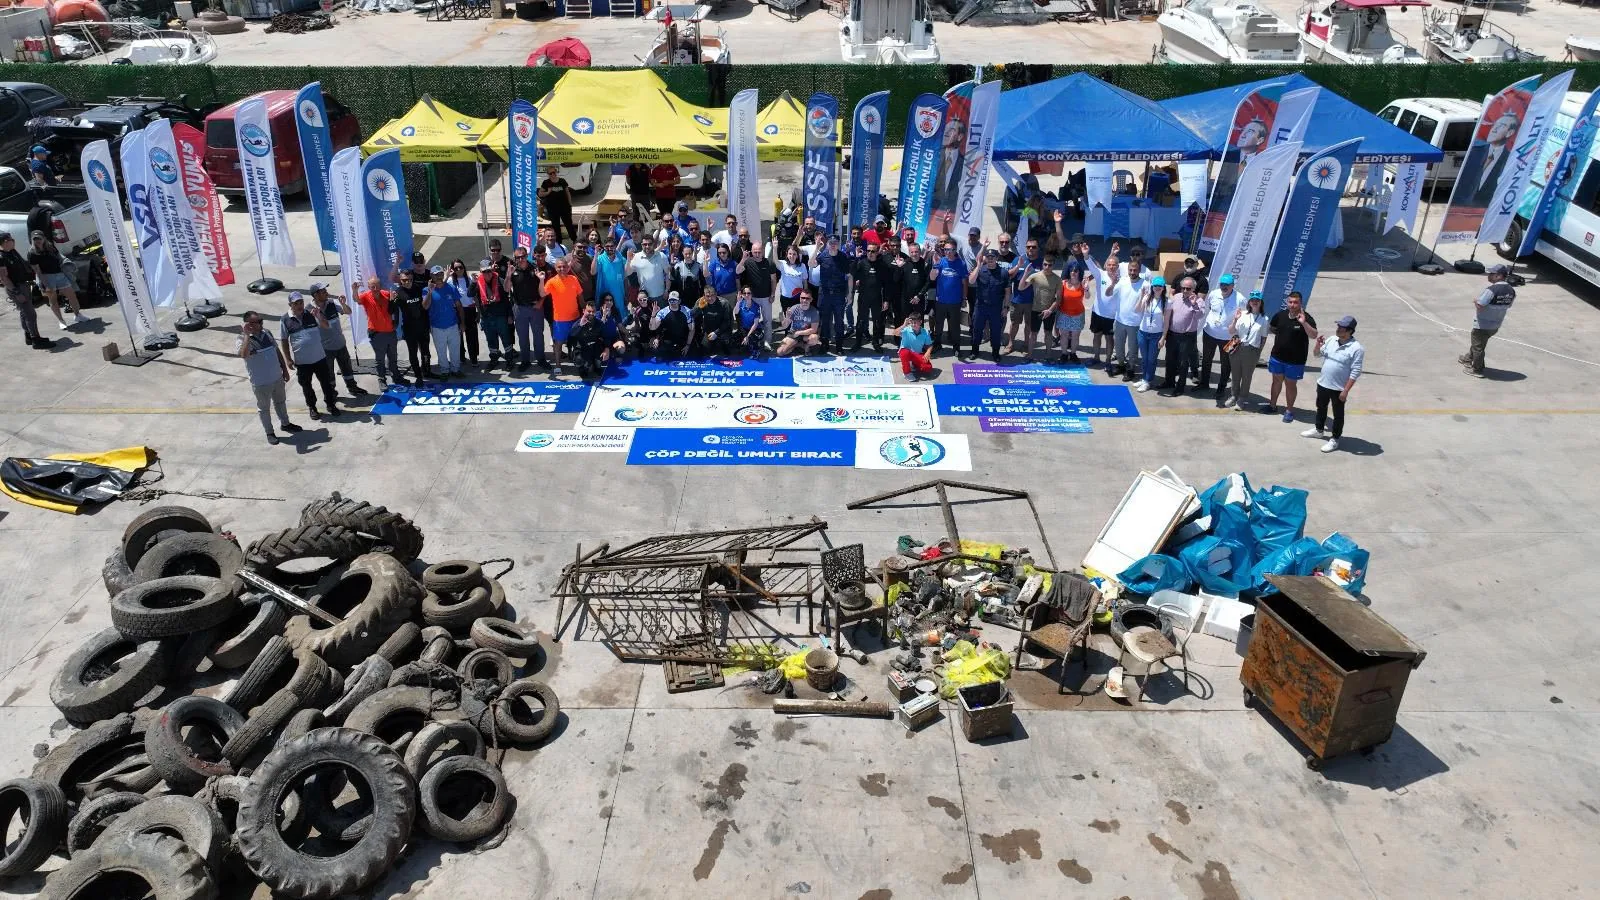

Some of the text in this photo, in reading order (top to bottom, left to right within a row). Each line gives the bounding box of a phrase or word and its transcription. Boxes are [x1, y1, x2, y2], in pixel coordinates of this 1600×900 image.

[312, 133, 326, 172] BELEDİYESİ
[1550, 127, 1568, 140] KOMU
[514, 144, 523, 198] GÜVENLİK
[1110, 152, 1184, 161] BELEDİYESİ
[1356, 154, 1412, 164] LEDİYESİ
[340, 172, 354, 225] BELEDİYESİ
[525, 154, 533, 228] KOMUTANLIĞI
[738, 154, 747, 206] BÜYÜKŞEHİR
[903, 194, 913, 224] SAHİL
[908, 138, 922, 194] GÜVENLİK
[914, 148, 935, 224] KOMUTANLIĞI
[256, 167, 278, 236] SUALTI SPORLARI
[182, 218, 202, 253] KULÜBÜ
[252, 204, 267, 241] ANTALYA
[381, 209, 397, 252] BELEDİYESİ
[1232, 167, 1272, 280] BÜYÜKŞEHİR BELEDİYESİ
[1285, 196, 1320, 296] BÜYÜKŞEHİR BELEDİYESİ
[116, 244, 138, 298] BÜYÜKŞEHİR
[133, 299, 152, 330] ANTALYA
[440, 386, 536, 395] ANTALYA
[701, 369, 764, 377] ZİRVEYE
[740, 390, 796, 399] DENİZ
[844, 392, 902, 400] TEMİZ
[984, 405, 1064, 414] TEMİZLİĞİ
[644, 449, 681, 458] ÇÖP
[684, 449, 734, 458] DEĞİL
[790, 451, 843, 459] BIRAK
